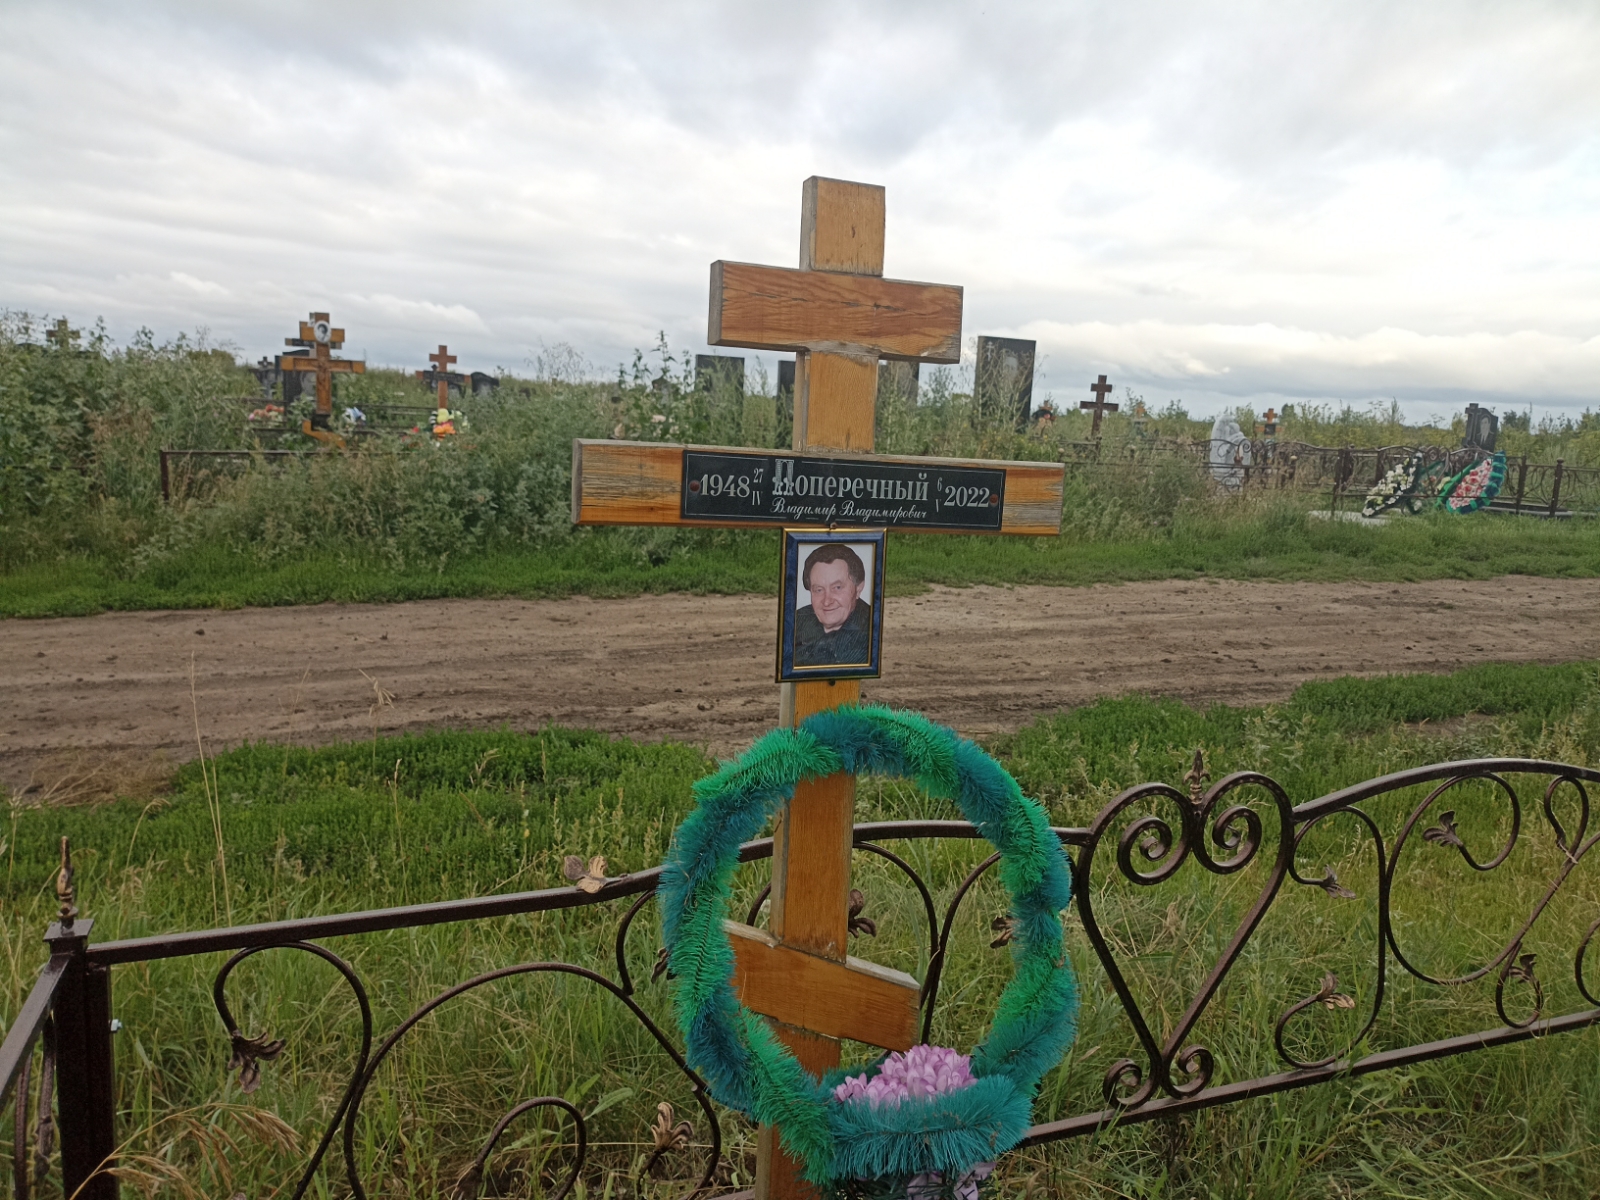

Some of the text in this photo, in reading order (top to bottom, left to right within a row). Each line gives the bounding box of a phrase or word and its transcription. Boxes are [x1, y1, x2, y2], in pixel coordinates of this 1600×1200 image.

[700, 473, 751, 498] 1948
[753, 467, 764, 483] 27
[772, 458, 930, 501] Поперечный
[944, 485, 990, 507] 2022
[770, 497, 928, 523] Владимир Владимирович
